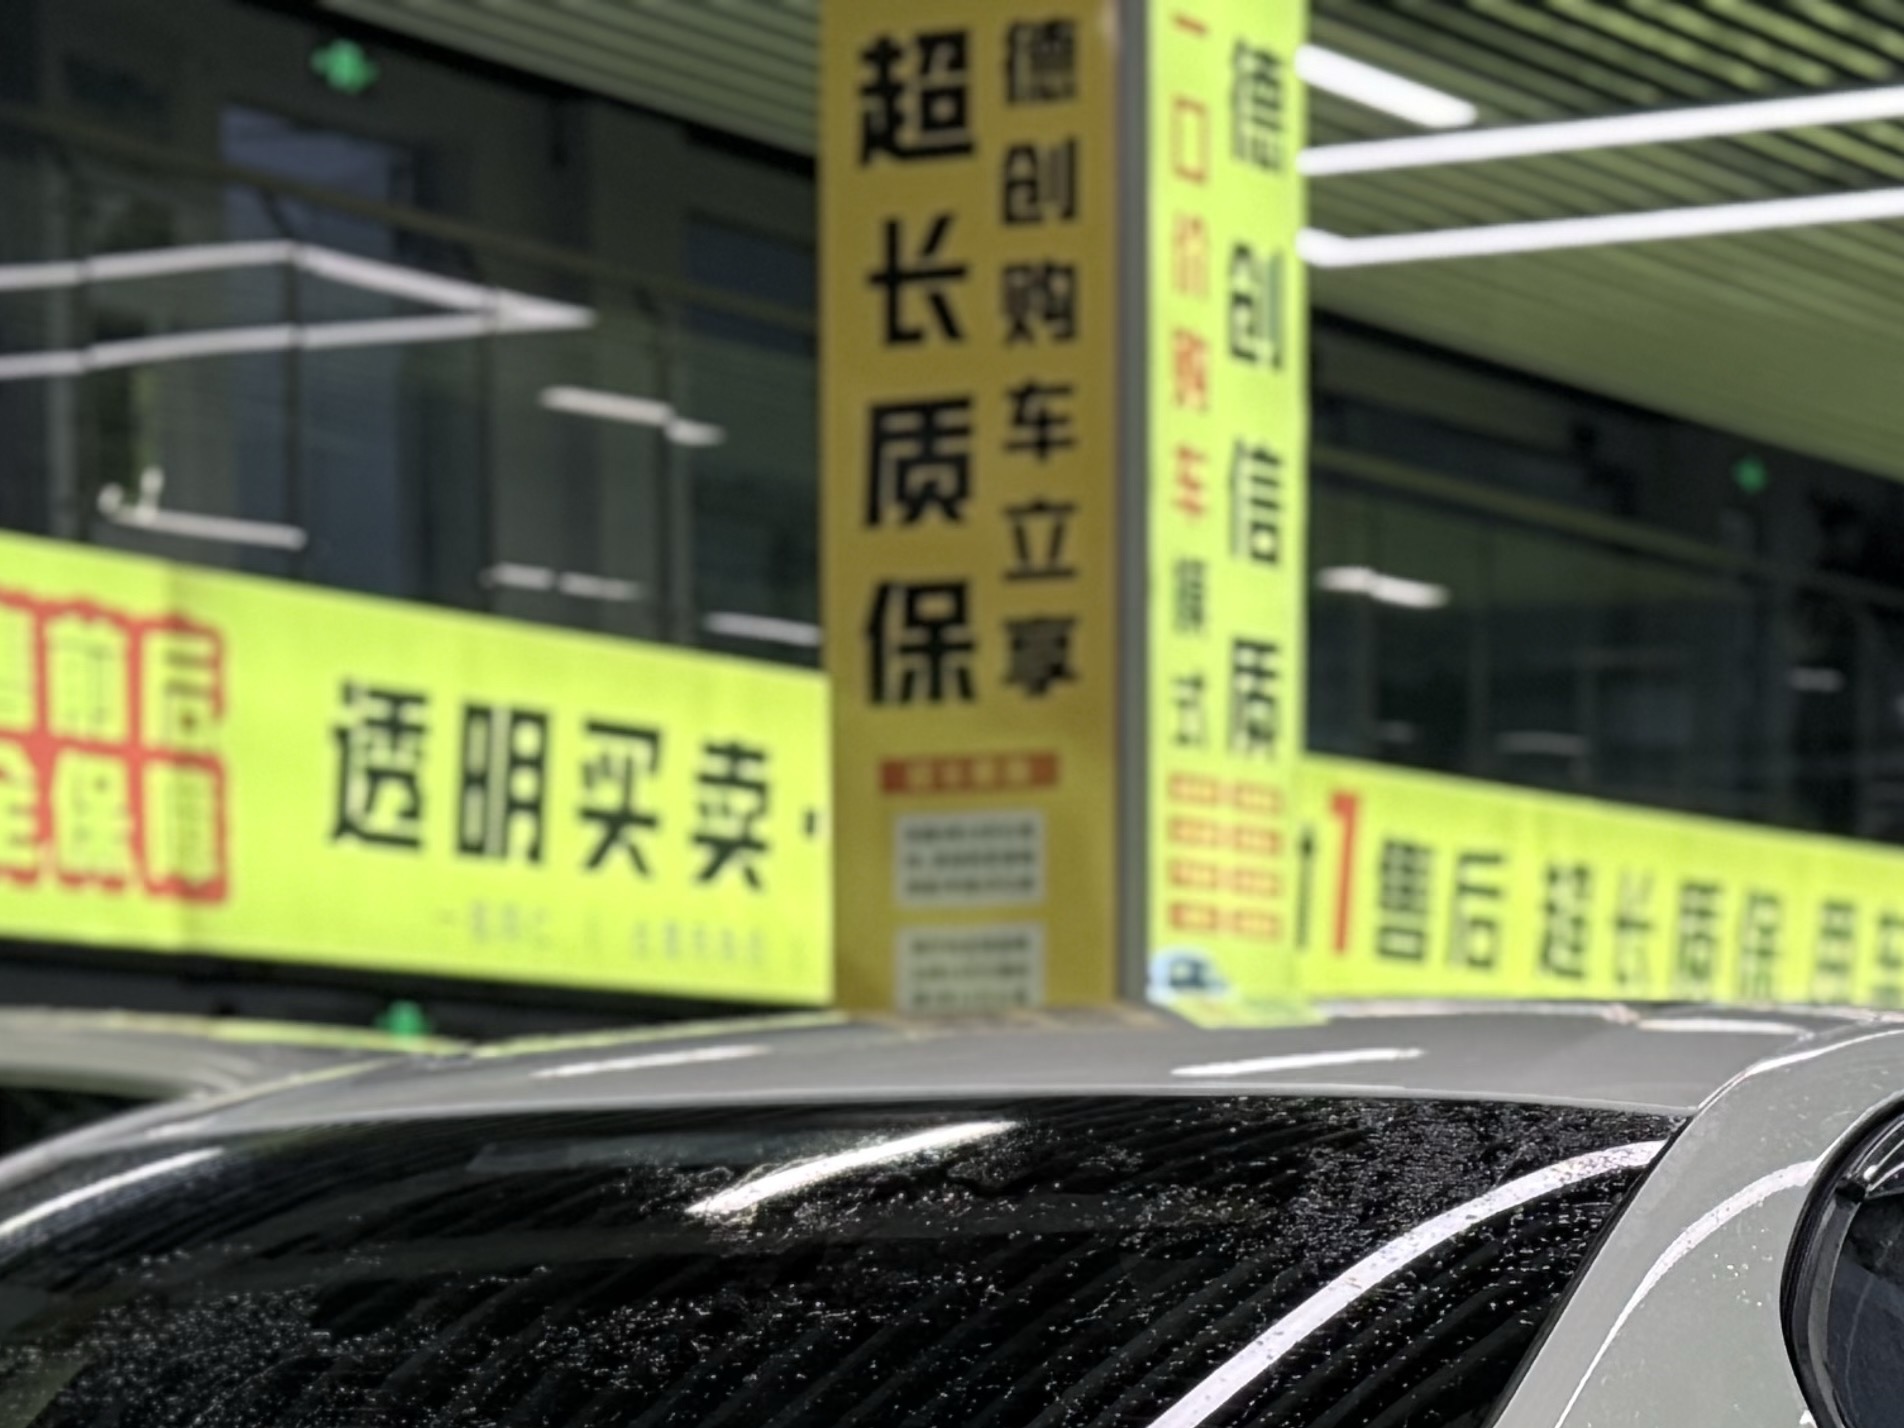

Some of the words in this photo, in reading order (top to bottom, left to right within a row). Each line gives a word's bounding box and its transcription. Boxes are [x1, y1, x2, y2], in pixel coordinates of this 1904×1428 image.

[857, 28, 976, 706] 超长质保
[1002, 16, 1080, 697] 德创购车立享
[327, 676, 772, 892] 透明买卖
